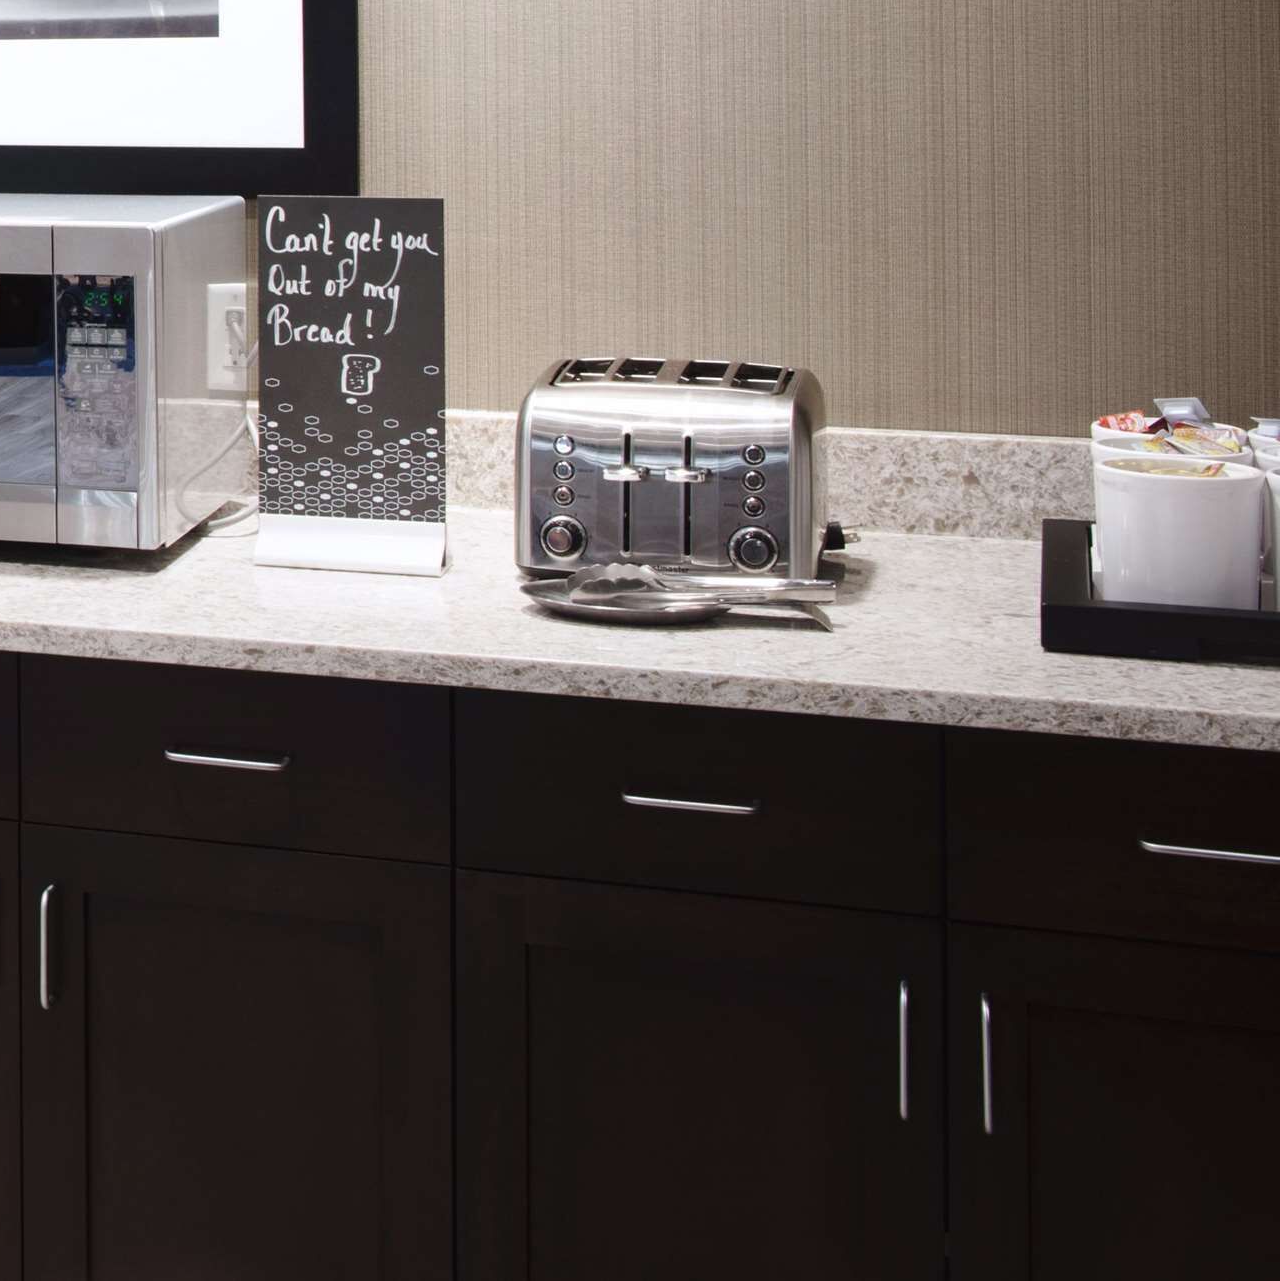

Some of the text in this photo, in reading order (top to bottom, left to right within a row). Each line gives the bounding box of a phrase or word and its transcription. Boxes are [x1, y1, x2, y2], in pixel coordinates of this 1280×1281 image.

[265, 205, 440, 290] Can't get you
[84, 292, 124, 307] 2:54
[266, 303, 355, 347] Bread
[267, 258, 401, 336] Out of my
